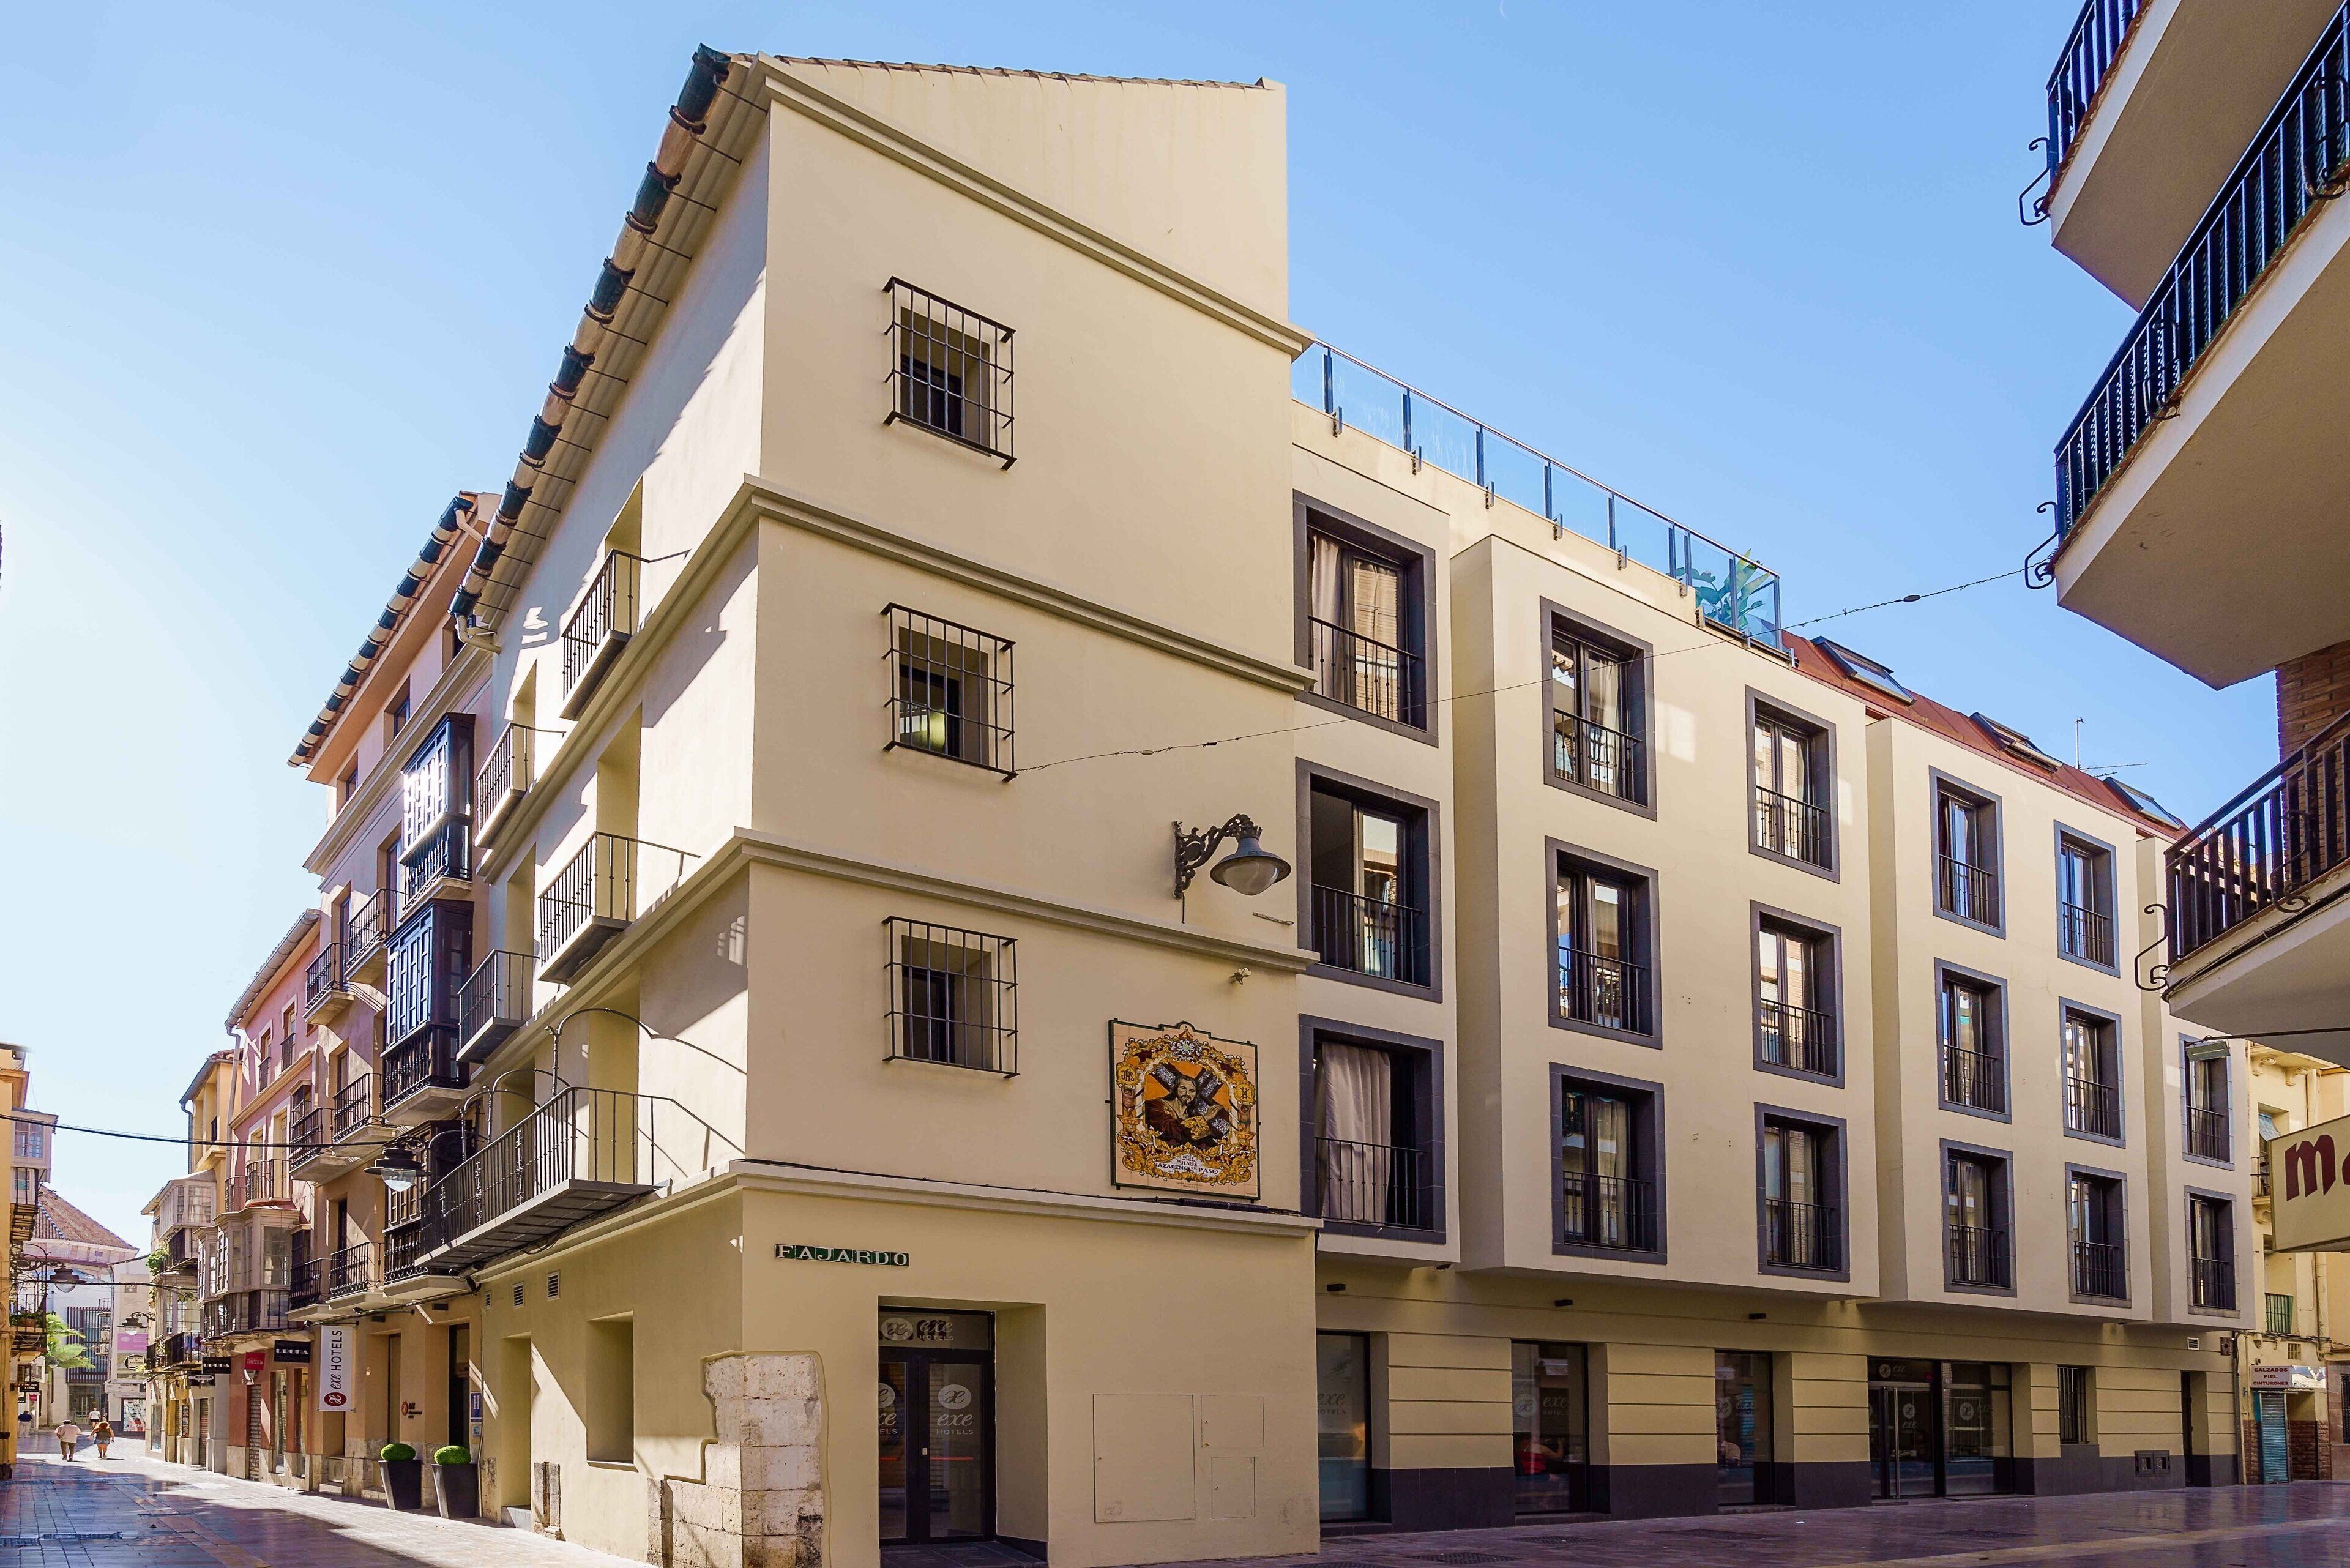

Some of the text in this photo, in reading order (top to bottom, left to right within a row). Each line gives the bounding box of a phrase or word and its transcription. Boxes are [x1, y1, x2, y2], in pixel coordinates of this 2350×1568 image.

[777, 1244, 908, 1266] FAJARDO
[920, 1321, 953, 1333] exe
[330, 1330, 343, 1371] HOTELS
[330, 1374, 341, 1390] exe
[474, 1395, 479, 1409] H
[937, 1414, 973, 1427] exe
